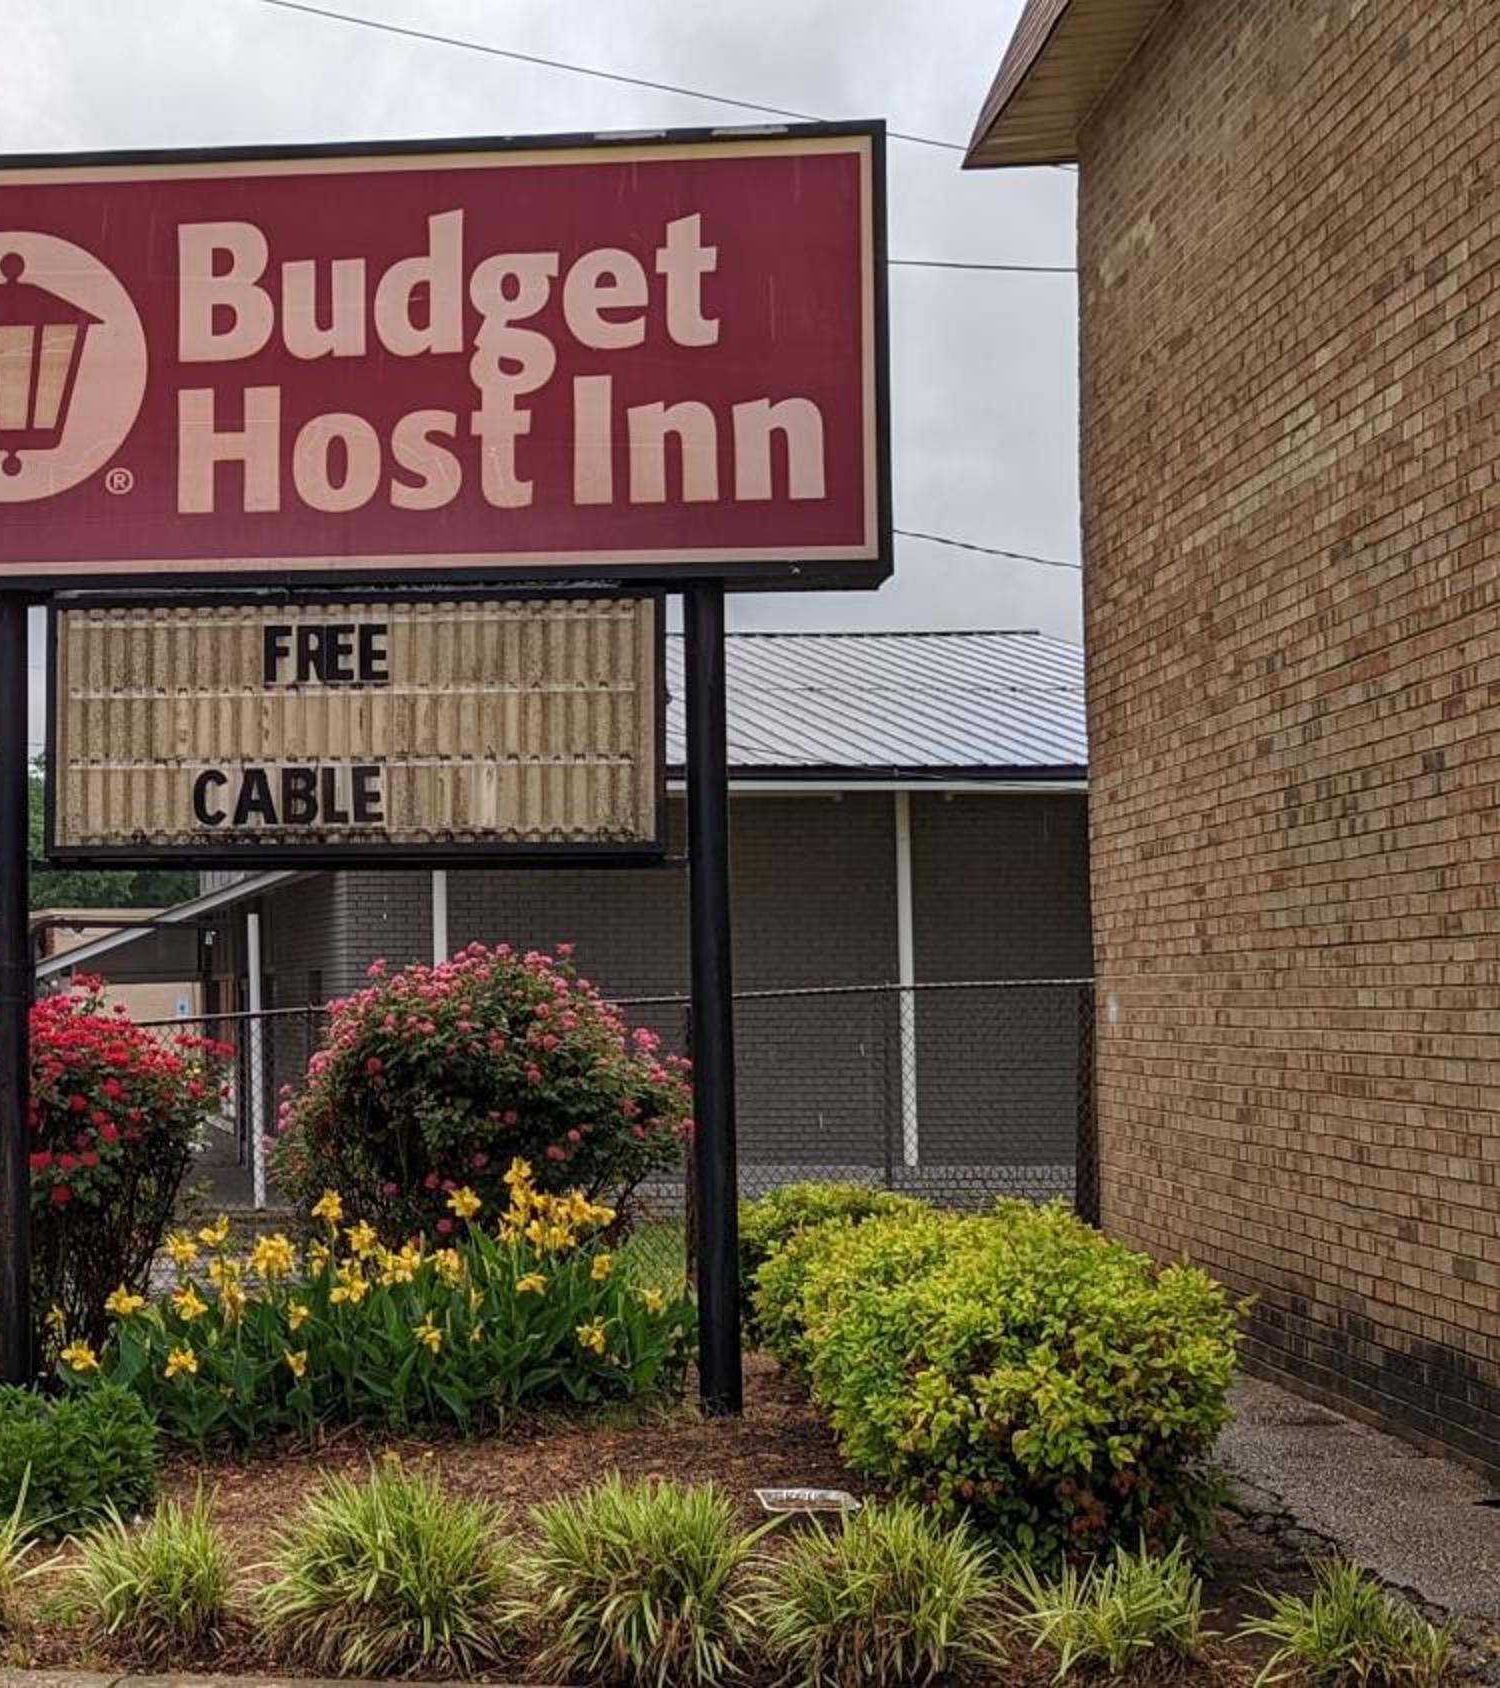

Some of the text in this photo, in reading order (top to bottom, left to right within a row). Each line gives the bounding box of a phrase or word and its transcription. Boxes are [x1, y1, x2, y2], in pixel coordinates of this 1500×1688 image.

[177, 209, 719, 396] Budget
[177, 375, 825, 513] Host Inn
[263, 623, 389, 683] FREE
[193, 765, 385, 826] CABLE
